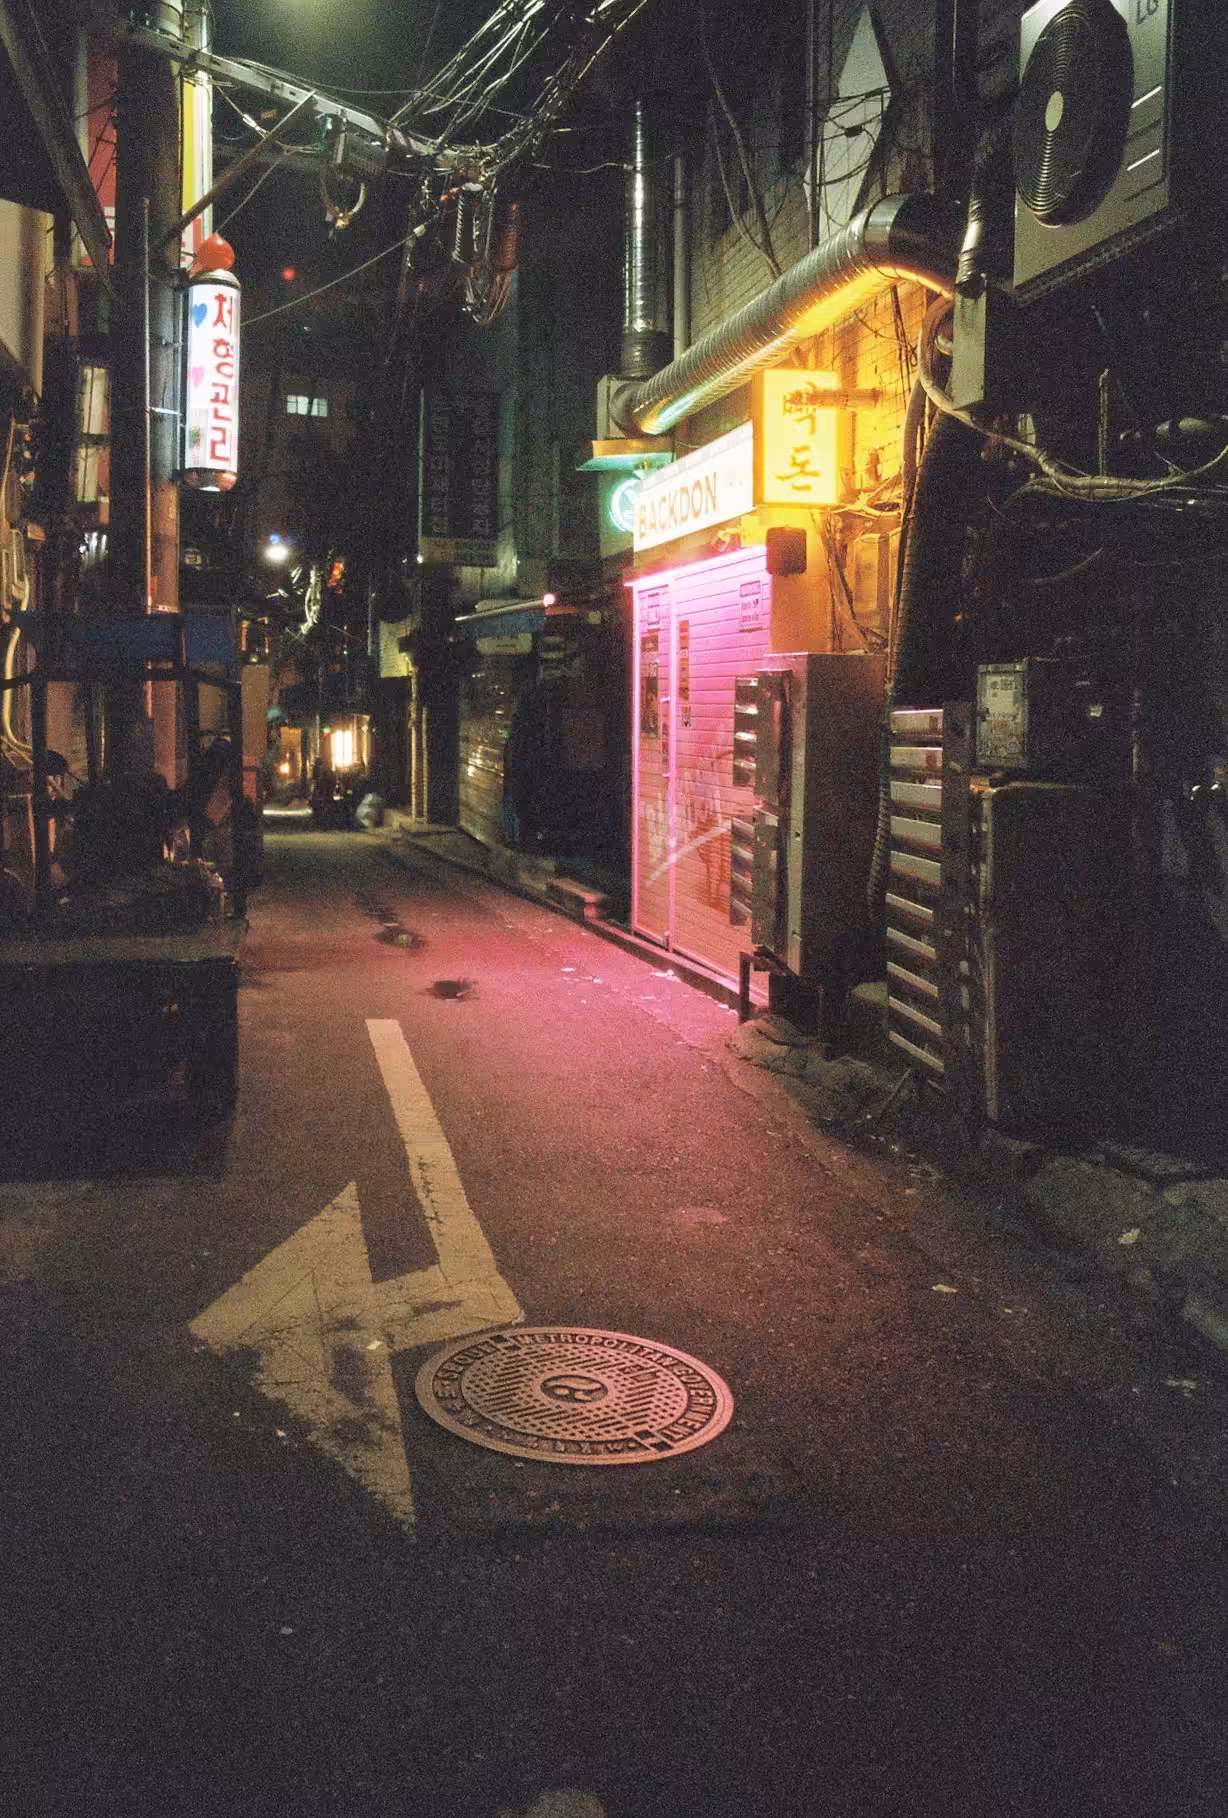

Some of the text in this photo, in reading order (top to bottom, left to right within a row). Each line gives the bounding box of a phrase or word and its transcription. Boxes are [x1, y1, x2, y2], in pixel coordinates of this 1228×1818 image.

[639, 472, 717, 538] BACKDON
[515, 1333, 678, 1366] METROPOLITAN
[662, 1367, 714, 1441] GOVERNMENT
